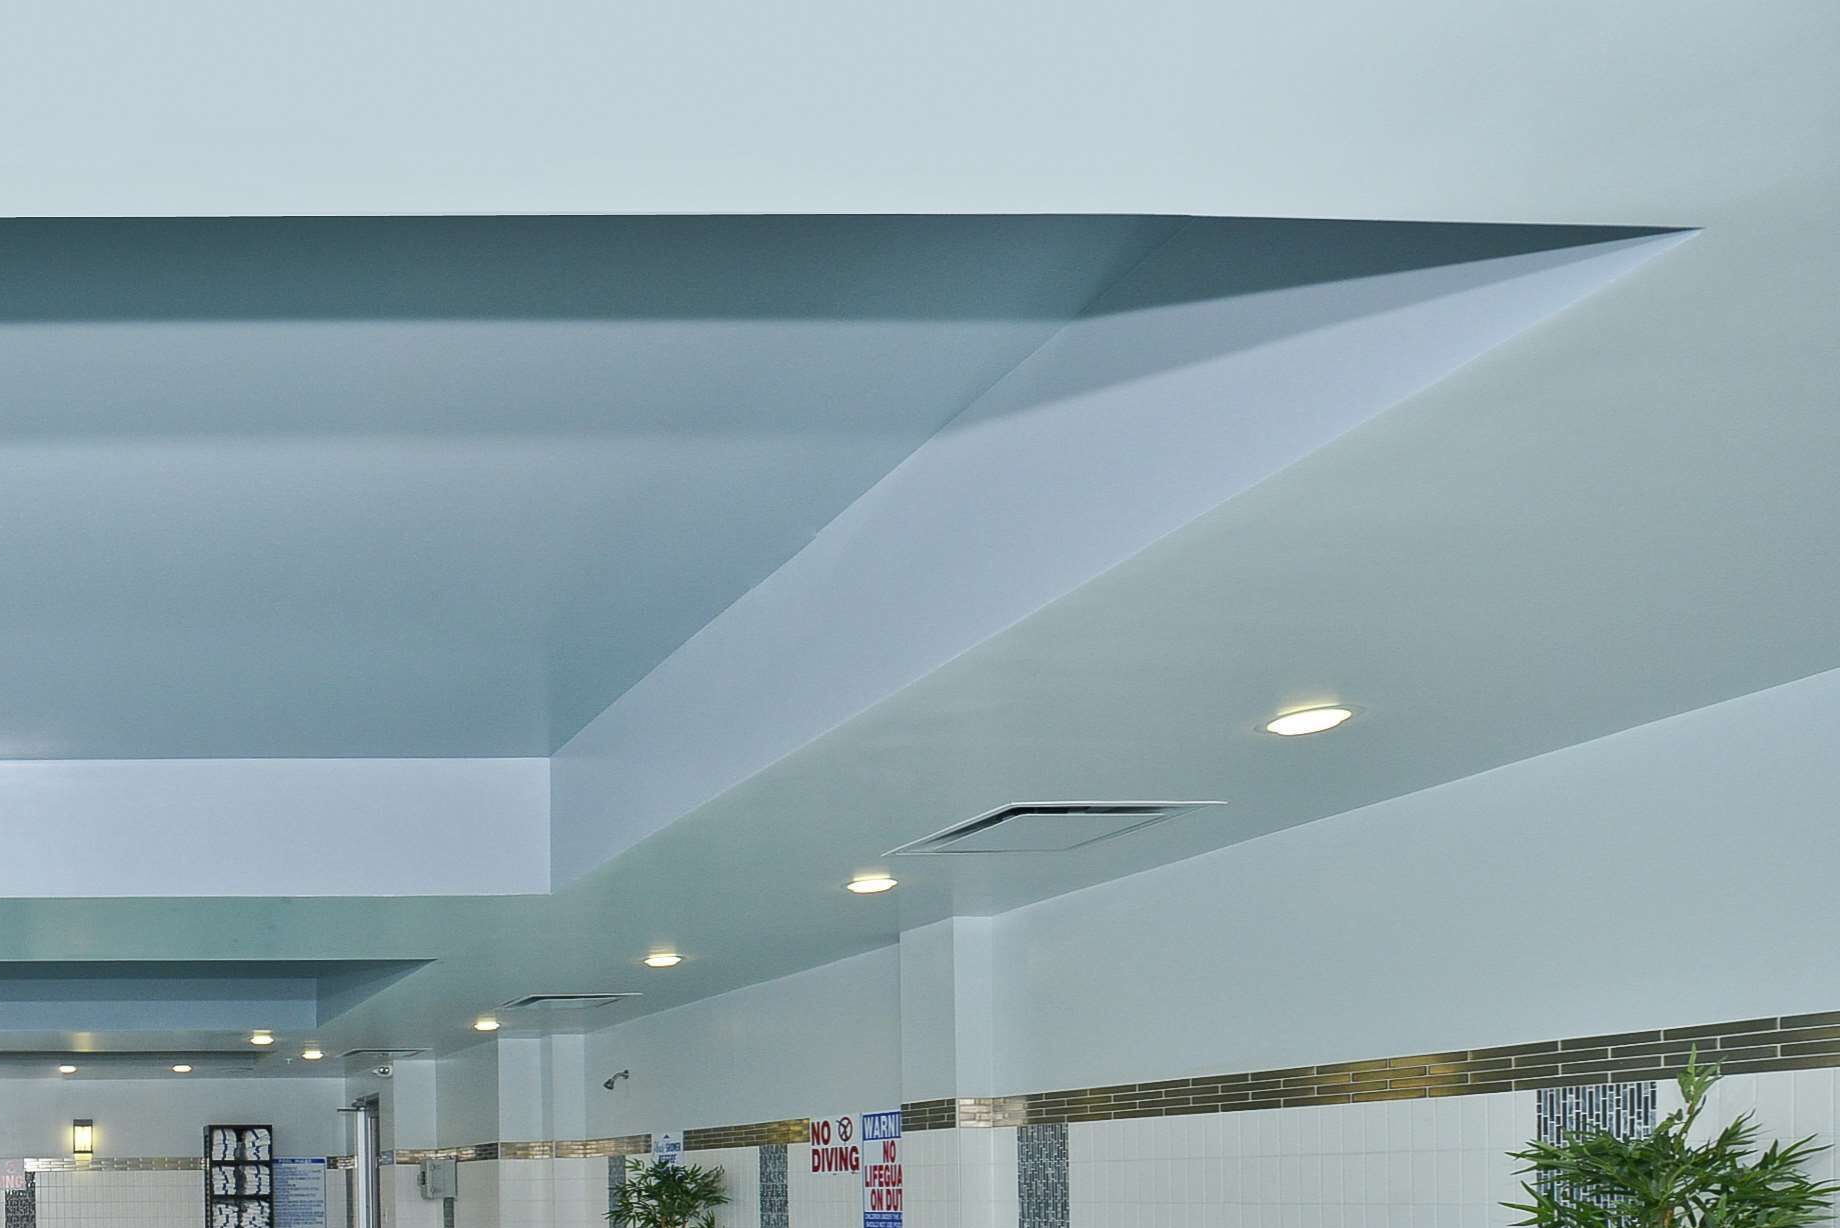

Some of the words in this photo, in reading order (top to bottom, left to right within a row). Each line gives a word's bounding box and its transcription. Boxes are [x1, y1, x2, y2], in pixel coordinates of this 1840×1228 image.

[811, 1120, 831, 1146] NO
[811, 1146, 860, 1173] DIVING
[883, 1140, 896, 1163] NO
[870, 1188, 884, 1211] ON
